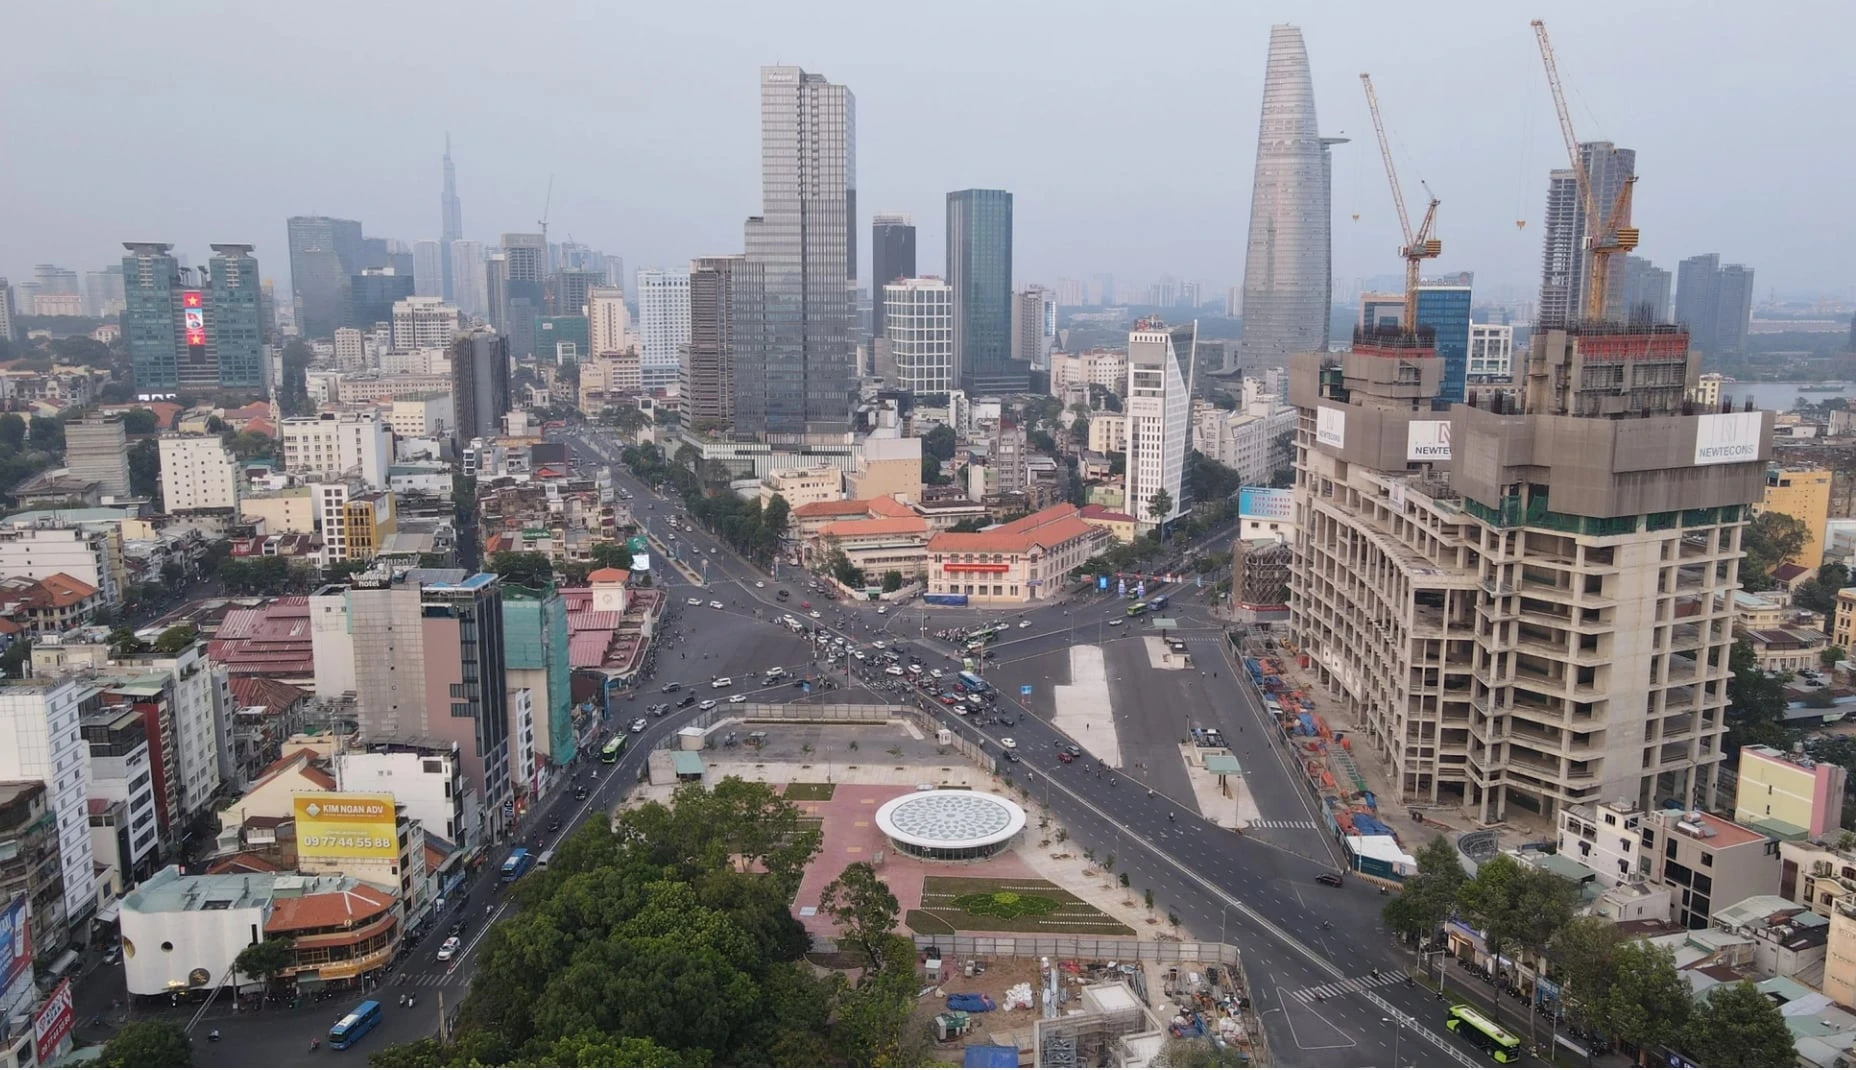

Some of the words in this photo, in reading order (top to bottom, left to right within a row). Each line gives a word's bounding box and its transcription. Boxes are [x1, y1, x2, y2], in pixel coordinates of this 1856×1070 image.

[1700, 444, 1754, 457] NEWTECONS
[323, 804, 340, 813] KIM
[340, 805, 364, 814] NGAN
[366, 805, 384, 814] ADV
[304, 836, 319, 846] 09
[321, 836, 338, 846] 77
[338, 837, 353, 847] 44
[356, 837, 372, 848] 55
[375, 838, 390, 848] 88
